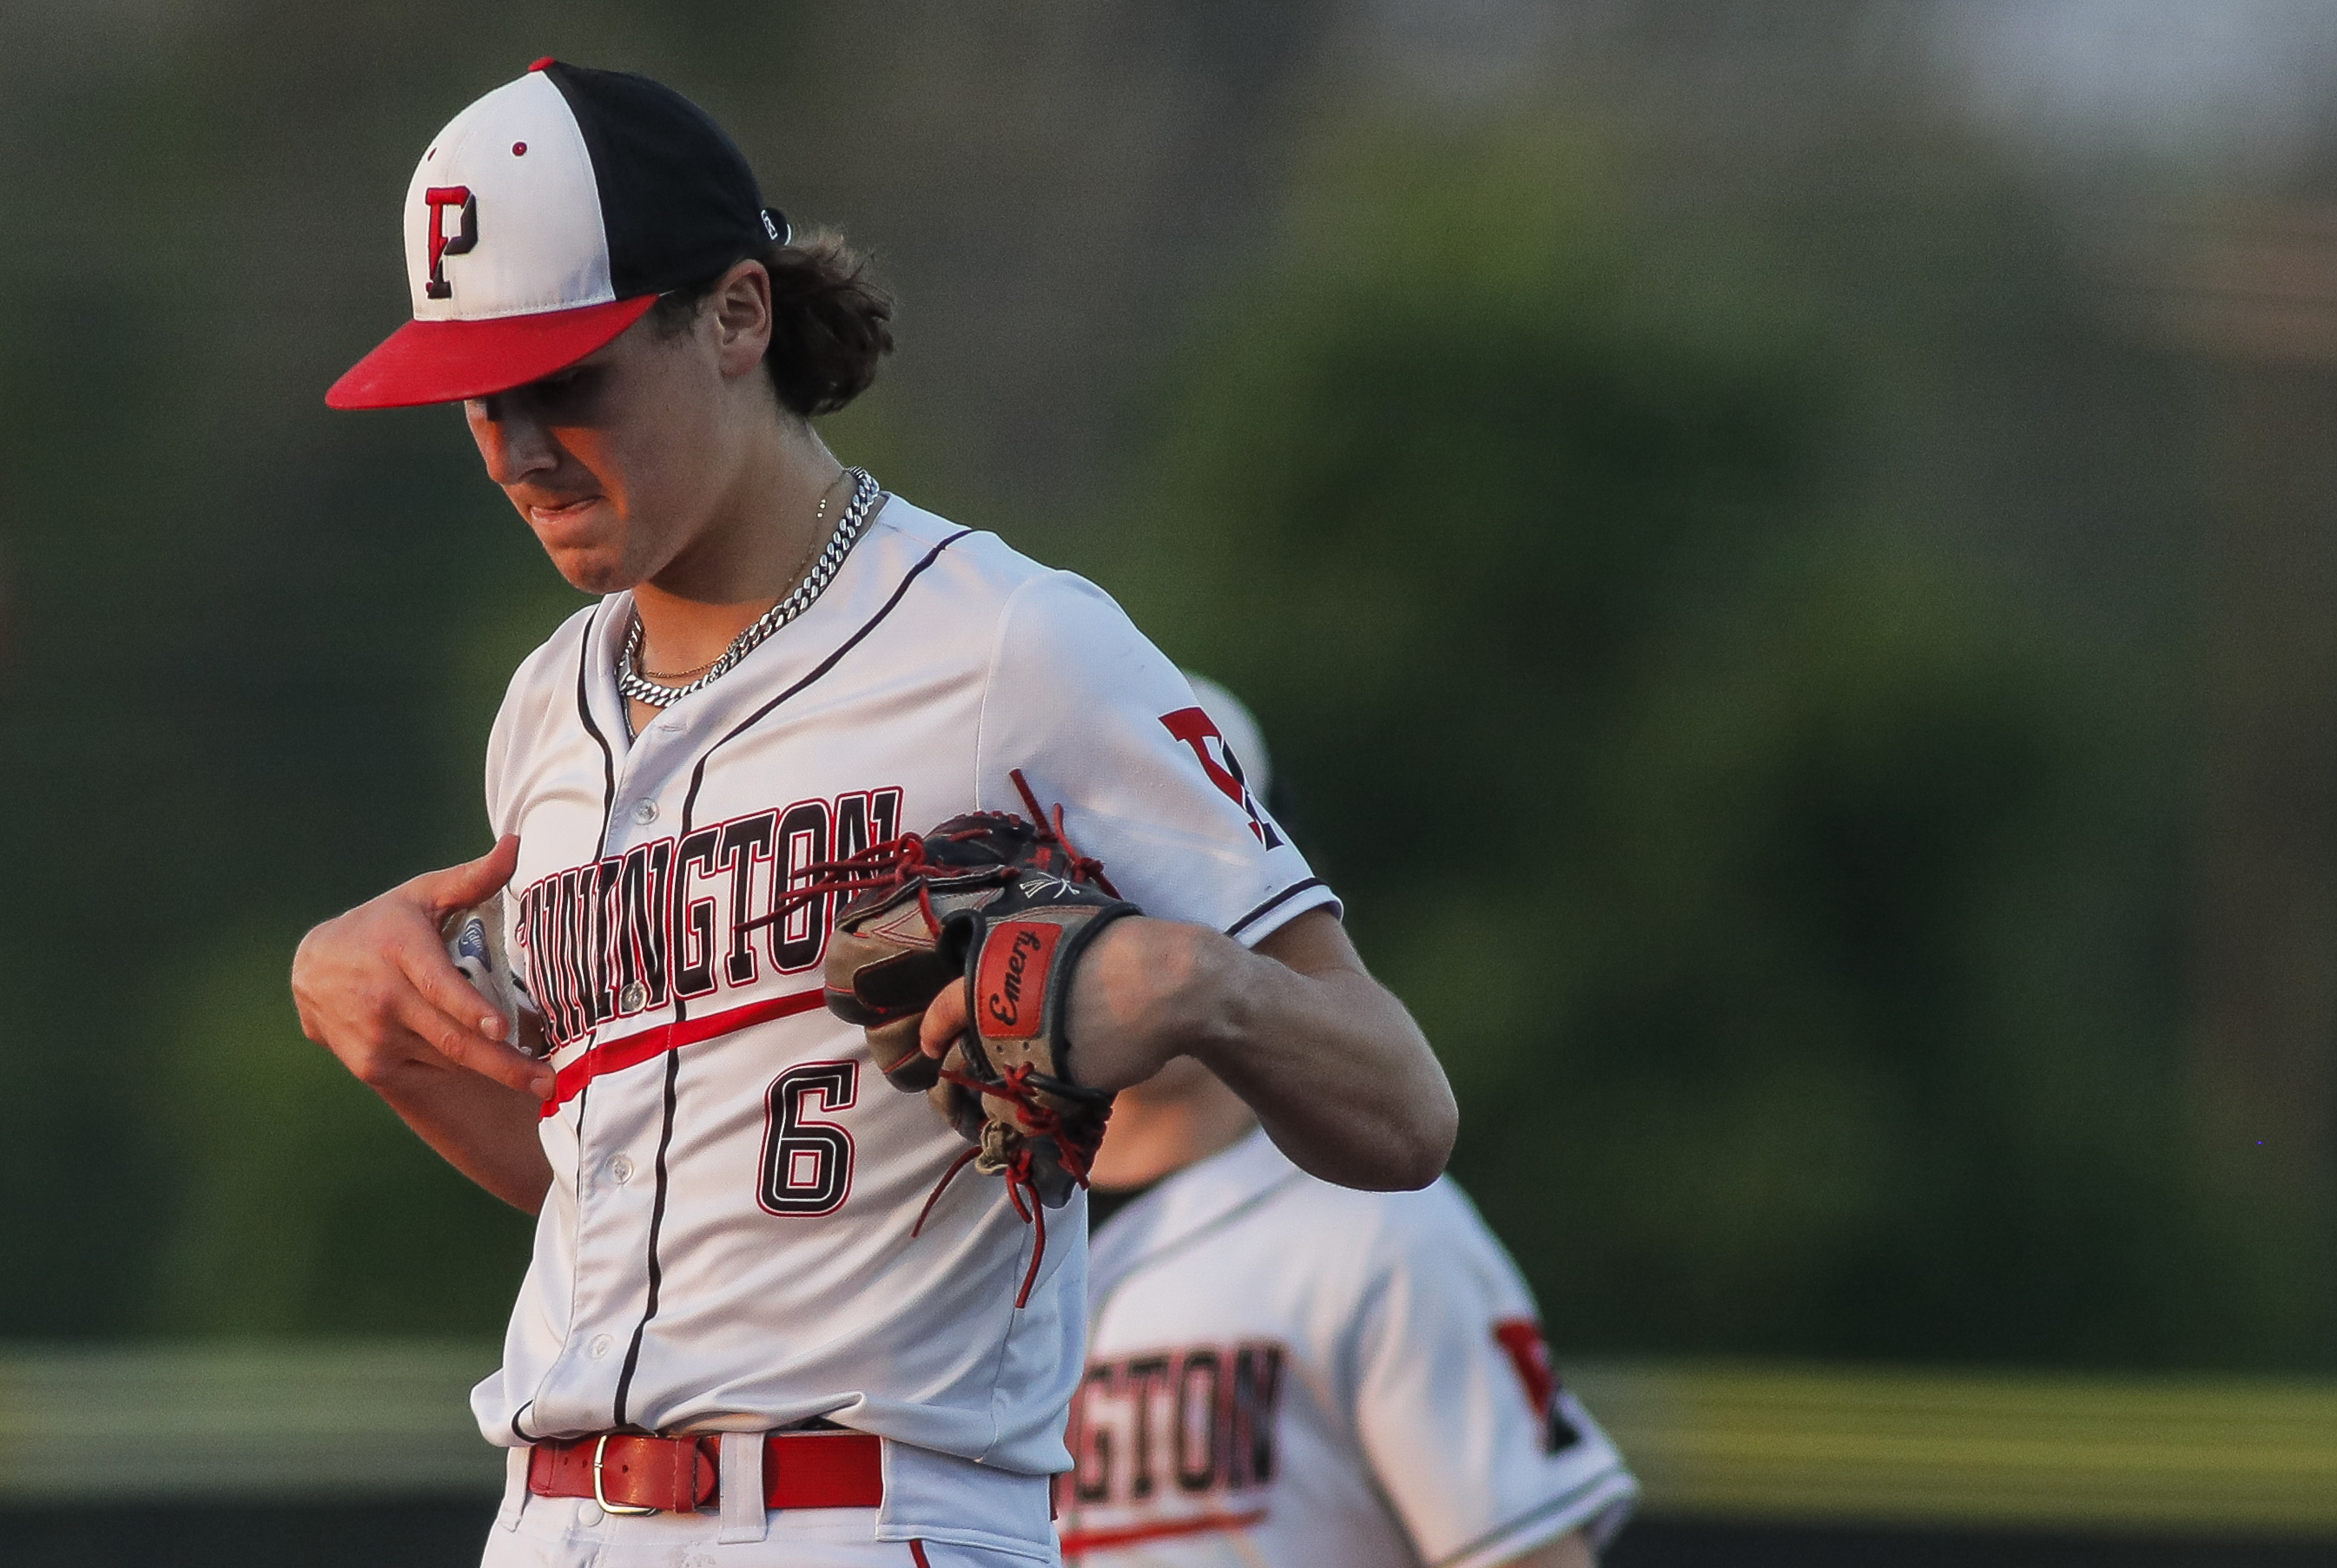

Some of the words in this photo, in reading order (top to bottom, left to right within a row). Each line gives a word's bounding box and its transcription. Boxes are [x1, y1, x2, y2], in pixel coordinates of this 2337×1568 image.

[425, 185, 478, 300] P
[516, 786, 903, 1049] NNINGTON
[990, 930, 1041, 1026] Emery
[756, 1059, 859, 1217] 6
